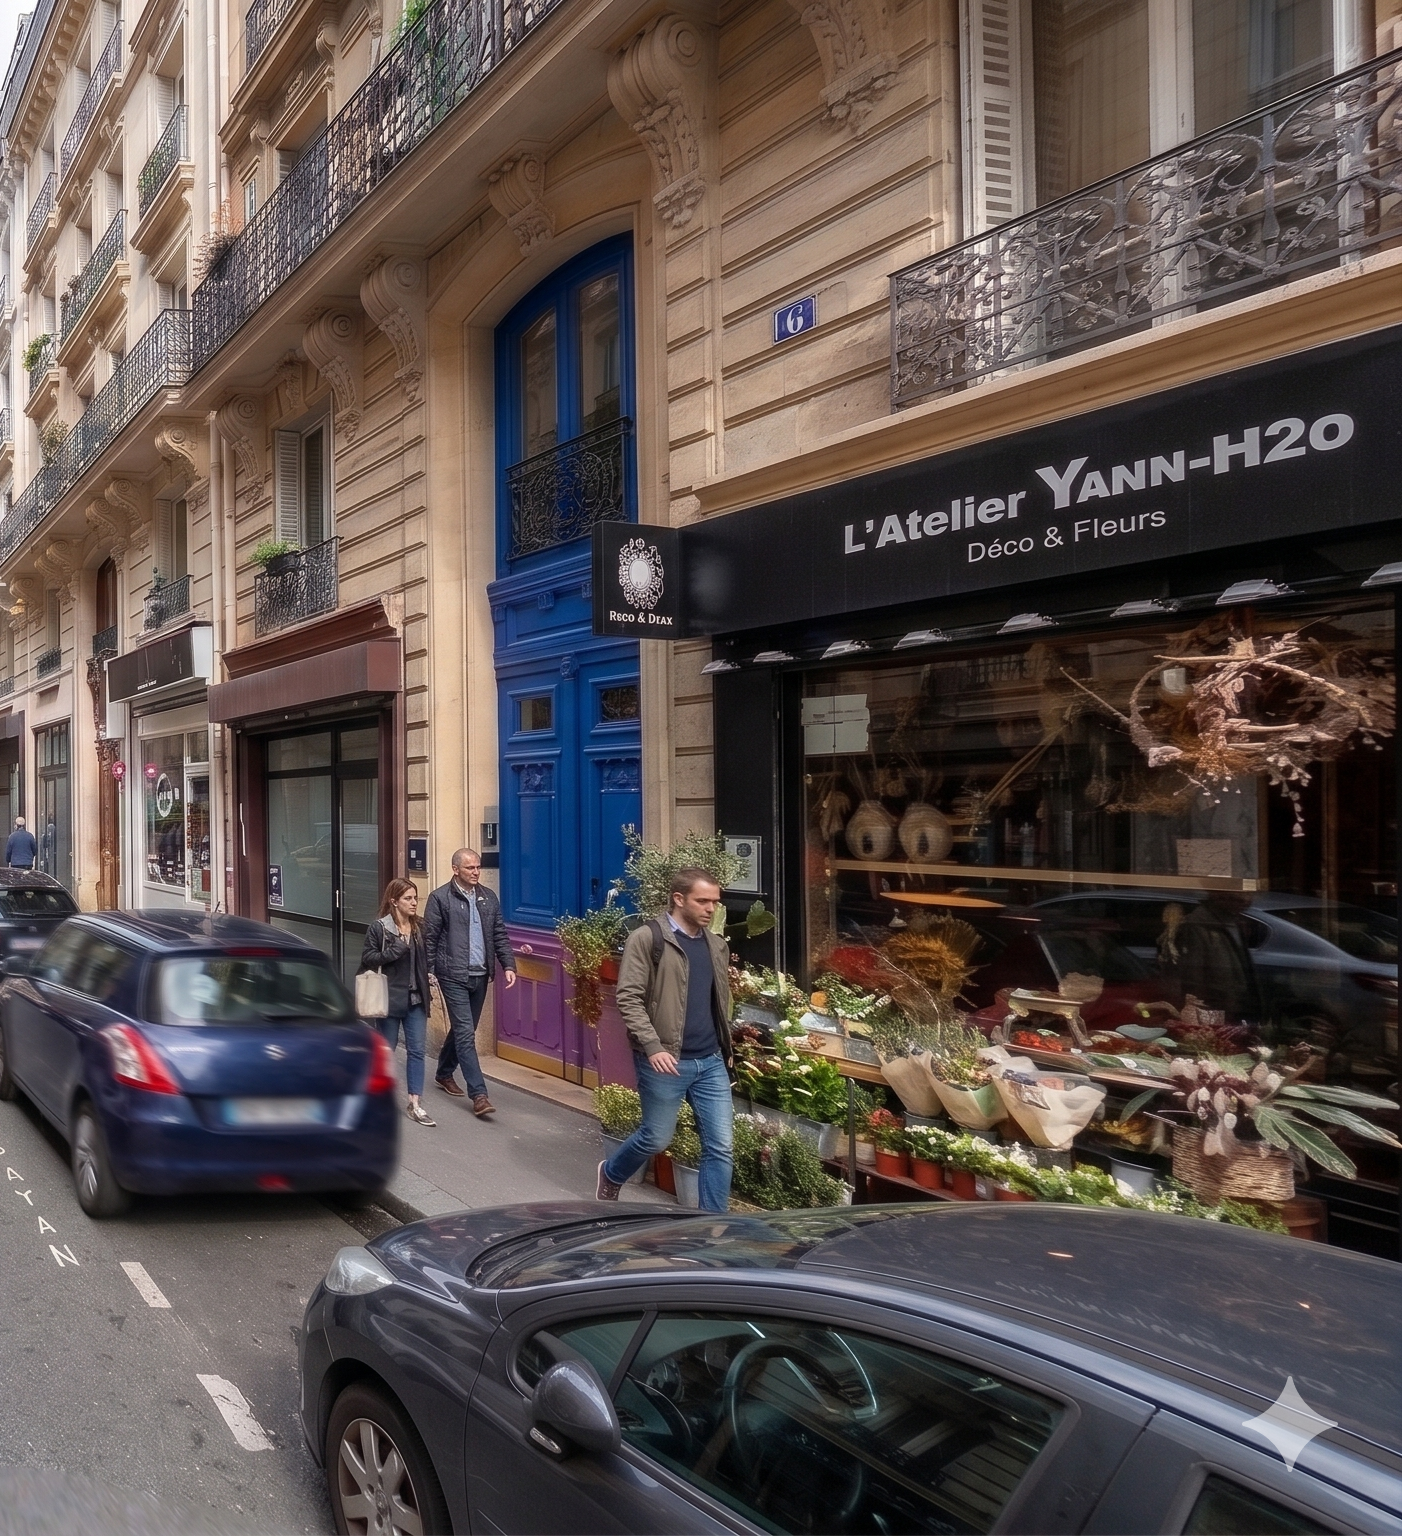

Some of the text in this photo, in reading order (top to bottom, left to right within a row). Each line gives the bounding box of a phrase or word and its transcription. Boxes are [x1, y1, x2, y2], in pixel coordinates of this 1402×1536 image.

[786, 304, 804, 334] 6
[844, 490, 1027, 555] L'Atelier
[968, 510, 1167, 563] Déco & Fleurs
[637, 612, 646, 624] &
